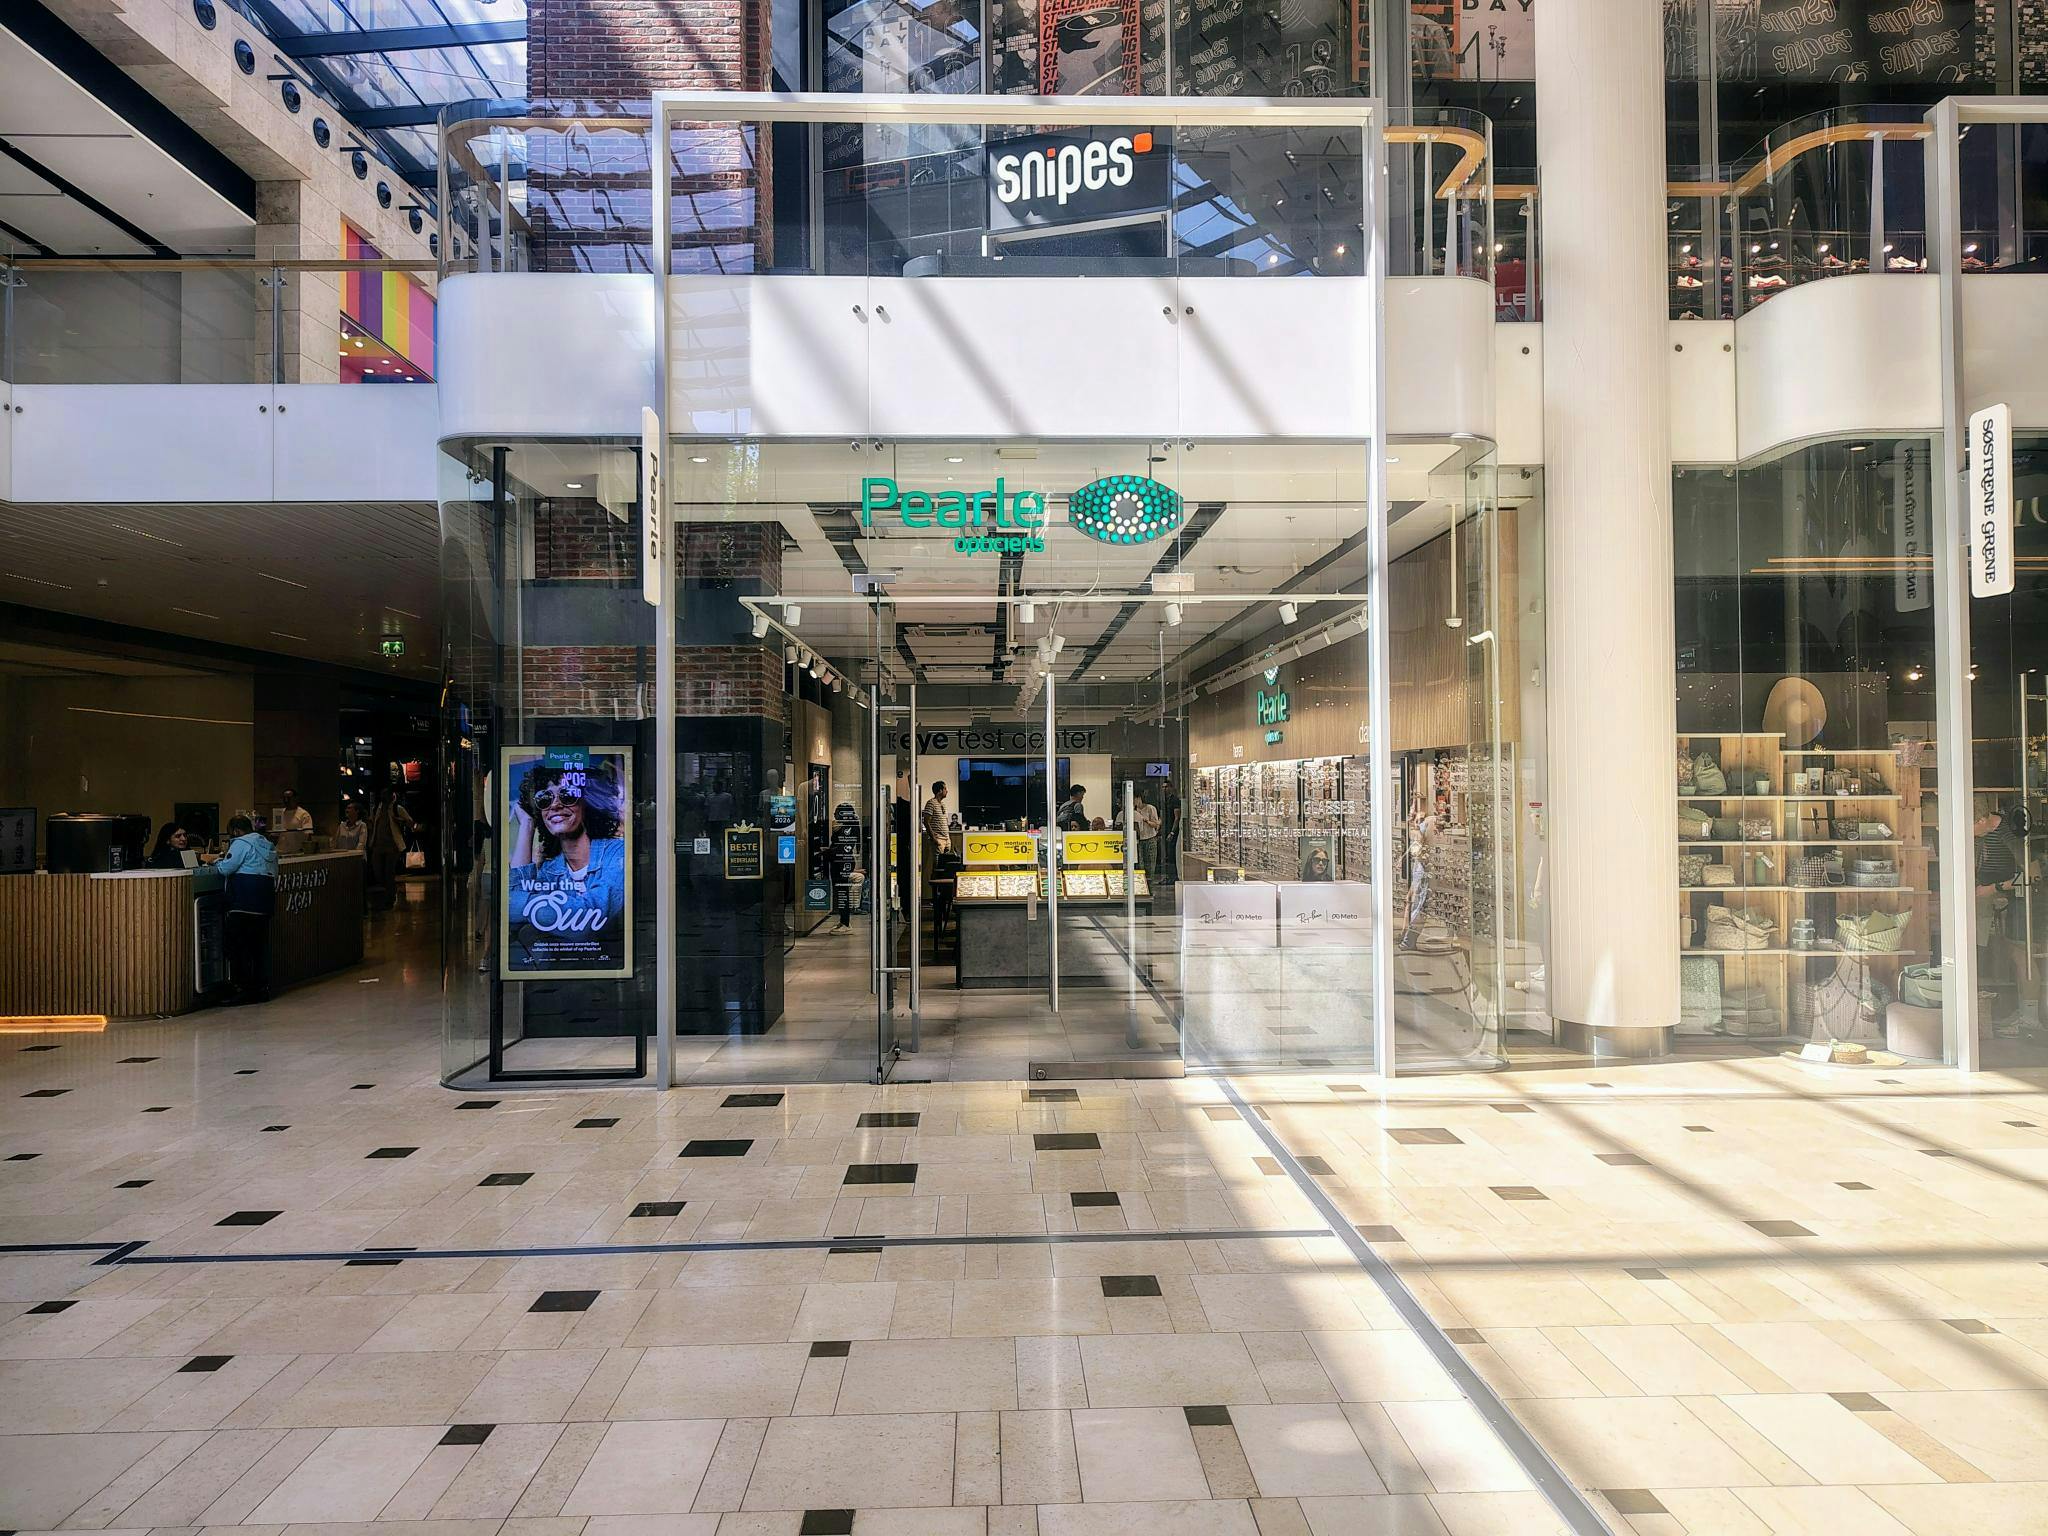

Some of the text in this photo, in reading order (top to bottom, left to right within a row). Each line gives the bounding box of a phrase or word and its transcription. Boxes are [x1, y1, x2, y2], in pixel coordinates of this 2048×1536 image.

[1773, 28, 1853, 75] snipes
[1880, 29, 1960, 75] snipes
[997, 137, 1133, 205] snipes
[1495, 293, 1526, 305] LE
[650, 452, 658, 560] Pearle
[861, 477, 1045, 528] Pearle
[1980, 418, 1995, 583] SØSTRENE GRENE
[954, 535, 1045, 557] opticiens
[1257, 685, 1288, 727] Pearle
[899, 732, 949, 755] eye
[957, 728, 1003, 750] test
[730, 843, 758, 851] BESTE
[273, 867, 329, 893] AKBERRY
[520, 878, 582, 891] Wear the
[522, 890, 608, 932] Sun
[1245, 913, 1263, 921] Meta
[1340, 912, 1358, 920] Meta
